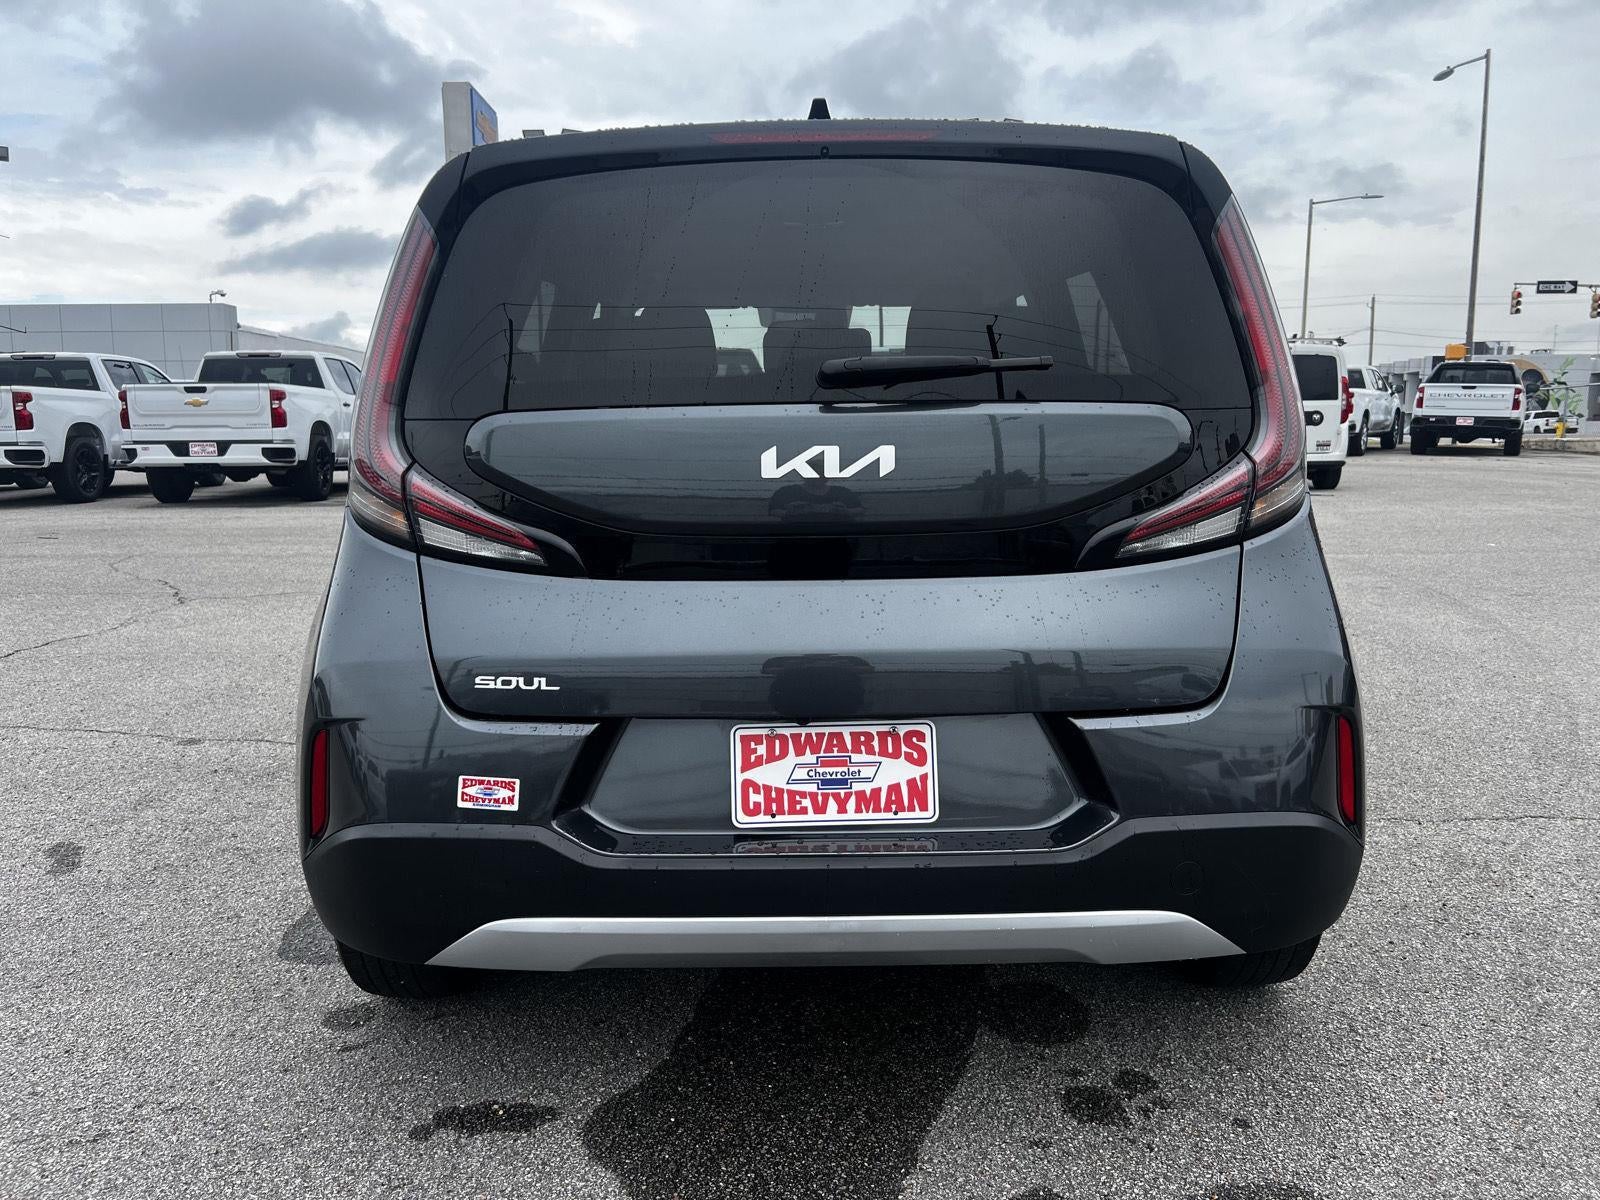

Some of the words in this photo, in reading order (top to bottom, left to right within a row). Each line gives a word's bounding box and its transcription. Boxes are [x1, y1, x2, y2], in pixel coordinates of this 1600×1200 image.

[761, 445, 895, 478] KIA
[474, 676, 560, 690] SOUL
[740, 729, 928, 774] EDWARDS
[806, 768, 862, 779] Chevrolet
[462, 778, 516, 793] EDWARDS
[461, 791, 515, 805] CHEVYMAN
[740, 772, 929, 817] CHEVYMAN
